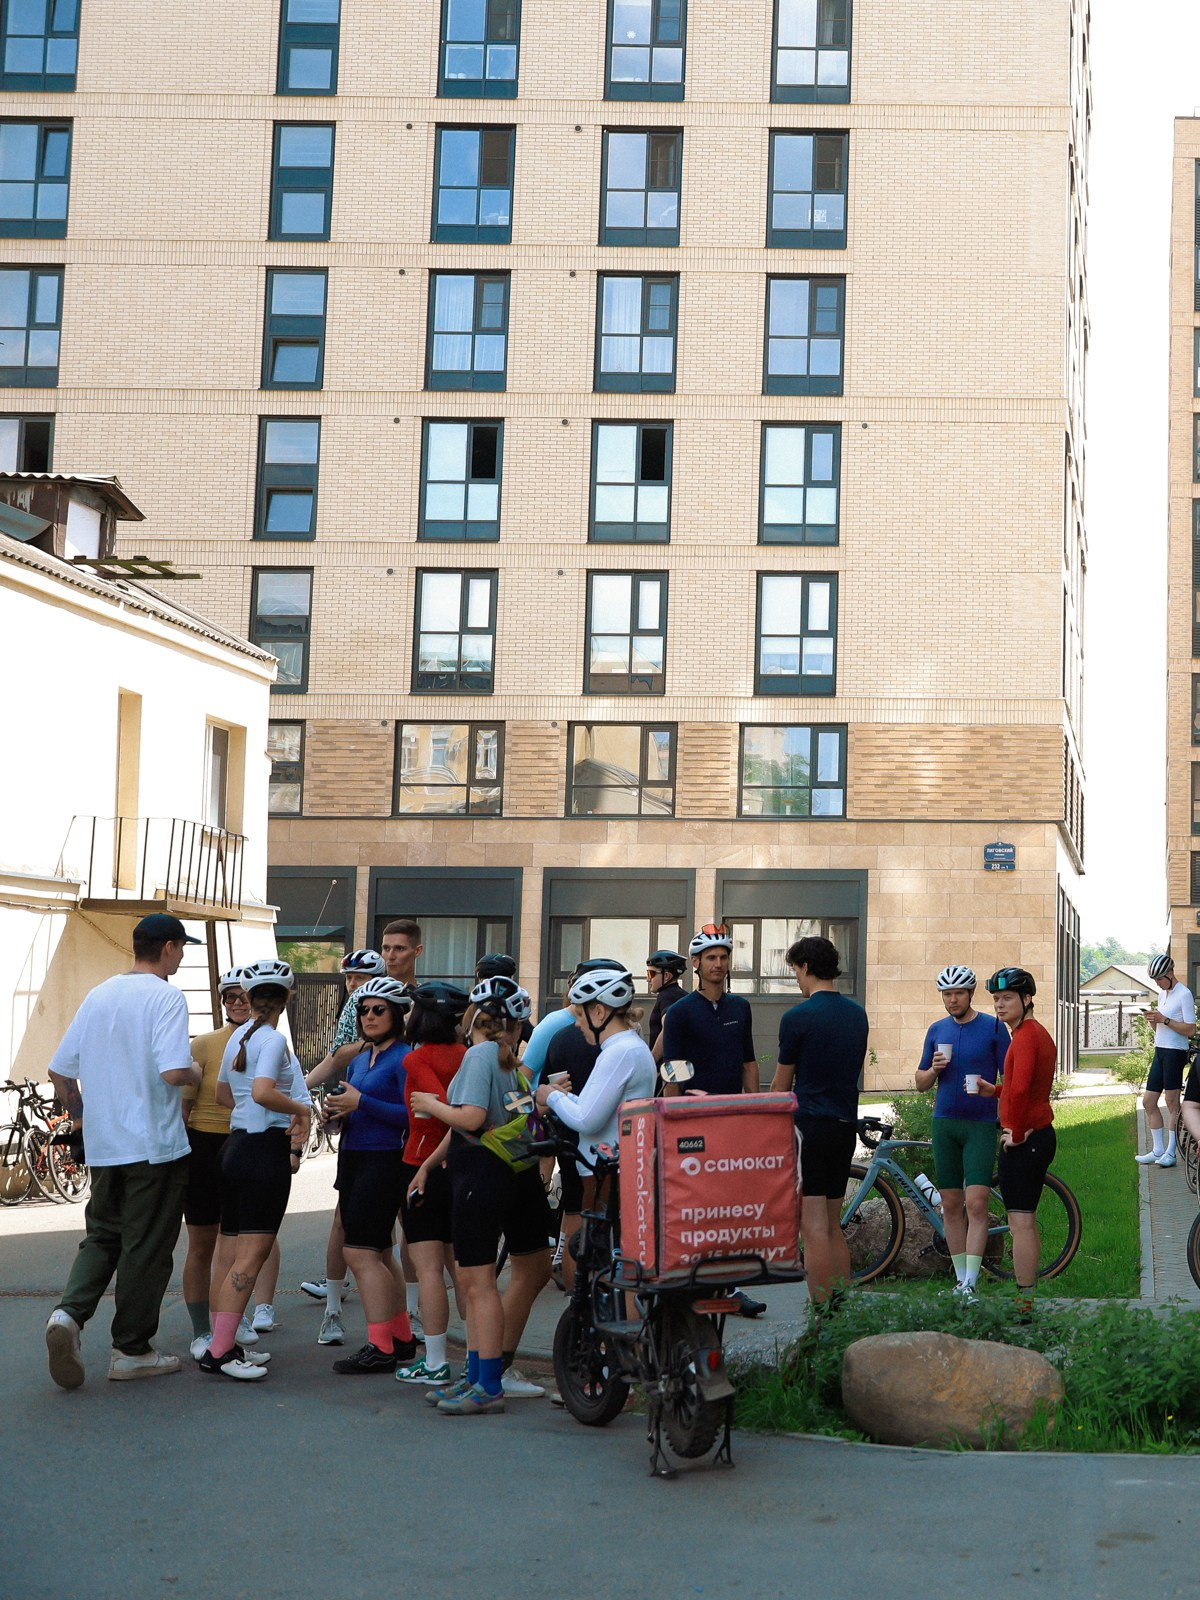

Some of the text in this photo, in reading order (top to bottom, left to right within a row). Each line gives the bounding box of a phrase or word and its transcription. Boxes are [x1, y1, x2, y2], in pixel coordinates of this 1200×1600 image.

[678, 1139, 703, 1149] 40662
[704, 1155, 784, 1172] самокат
[636, 1117, 649, 1266] samokat.ru
[893, 1171, 930, 1212] TWITTER
[681, 1203, 765, 1224] принесу
[680, 1225, 775, 1246] продукты
[680, 1252, 701, 1265] за
